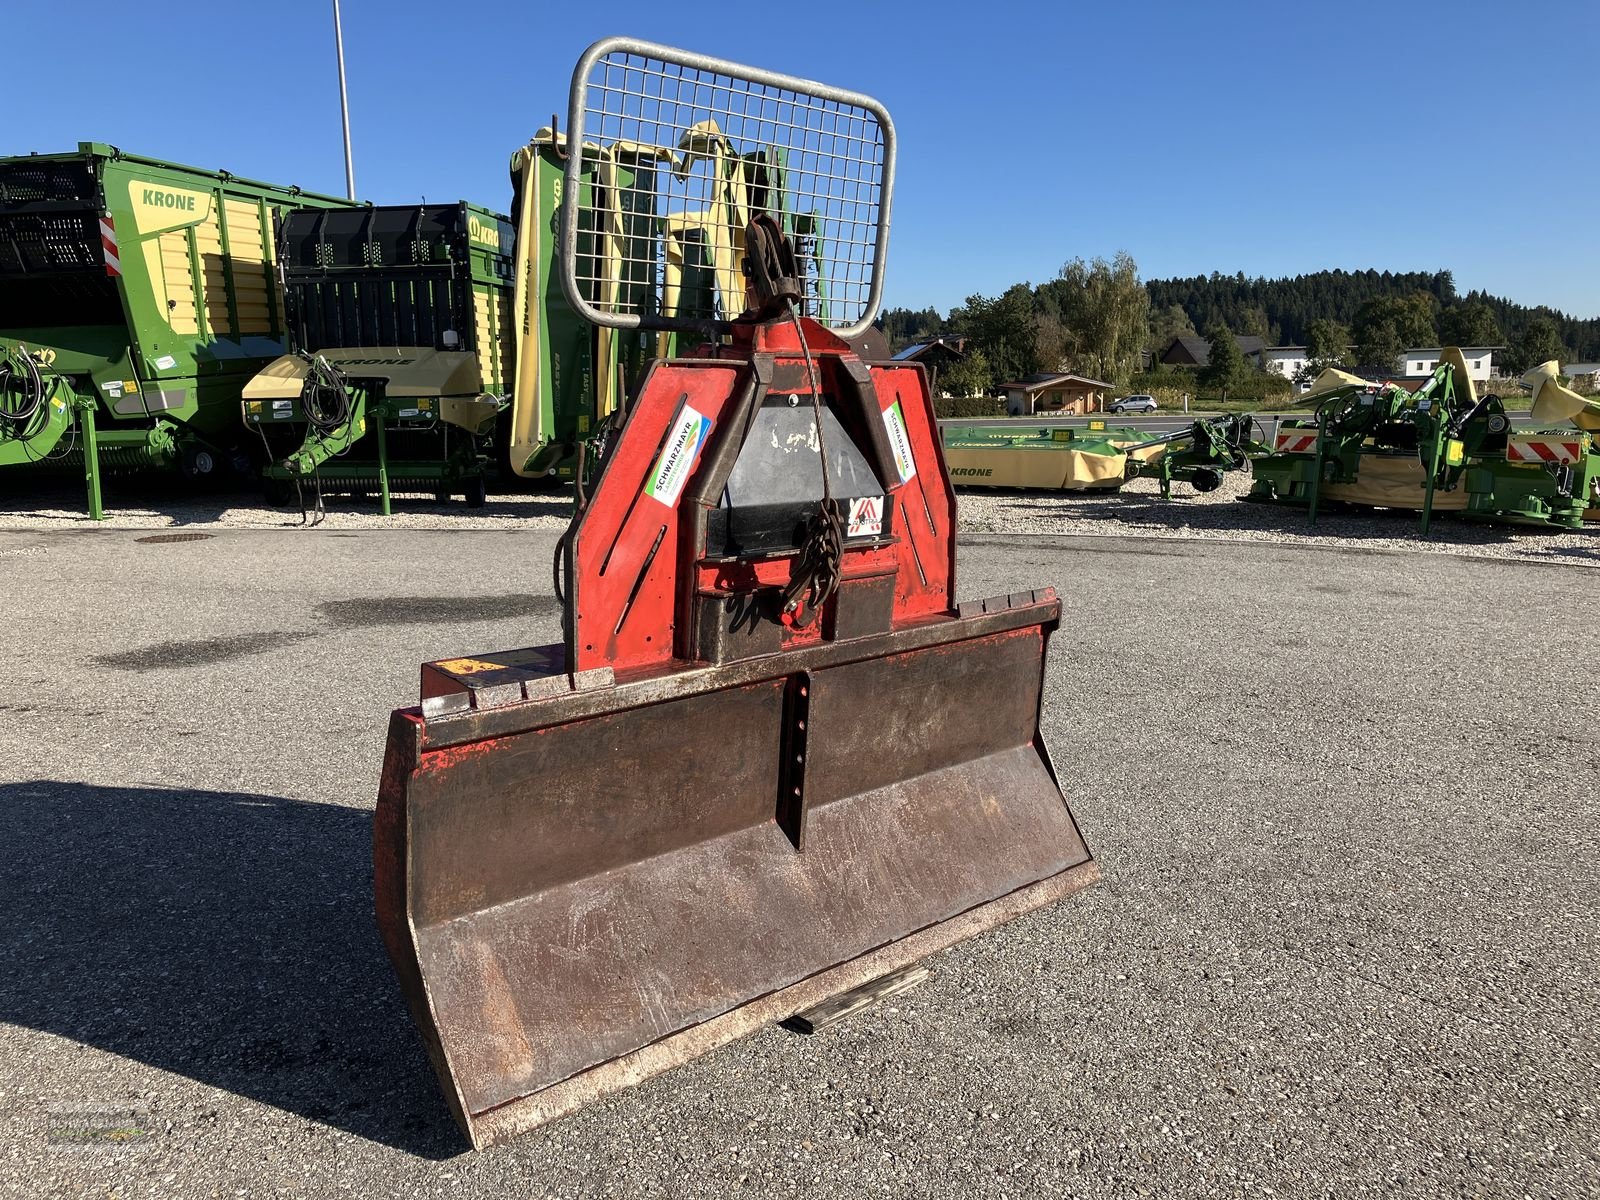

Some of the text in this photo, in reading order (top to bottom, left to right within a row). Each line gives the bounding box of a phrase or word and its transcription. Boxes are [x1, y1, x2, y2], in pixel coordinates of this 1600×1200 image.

[143, 189, 195, 211] KRONE
[655, 421, 692, 491] SCHWARZMAYR
[890, 412, 910, 470] SCHWARZMAYR
[951, 467, 993, 477] KRONE
